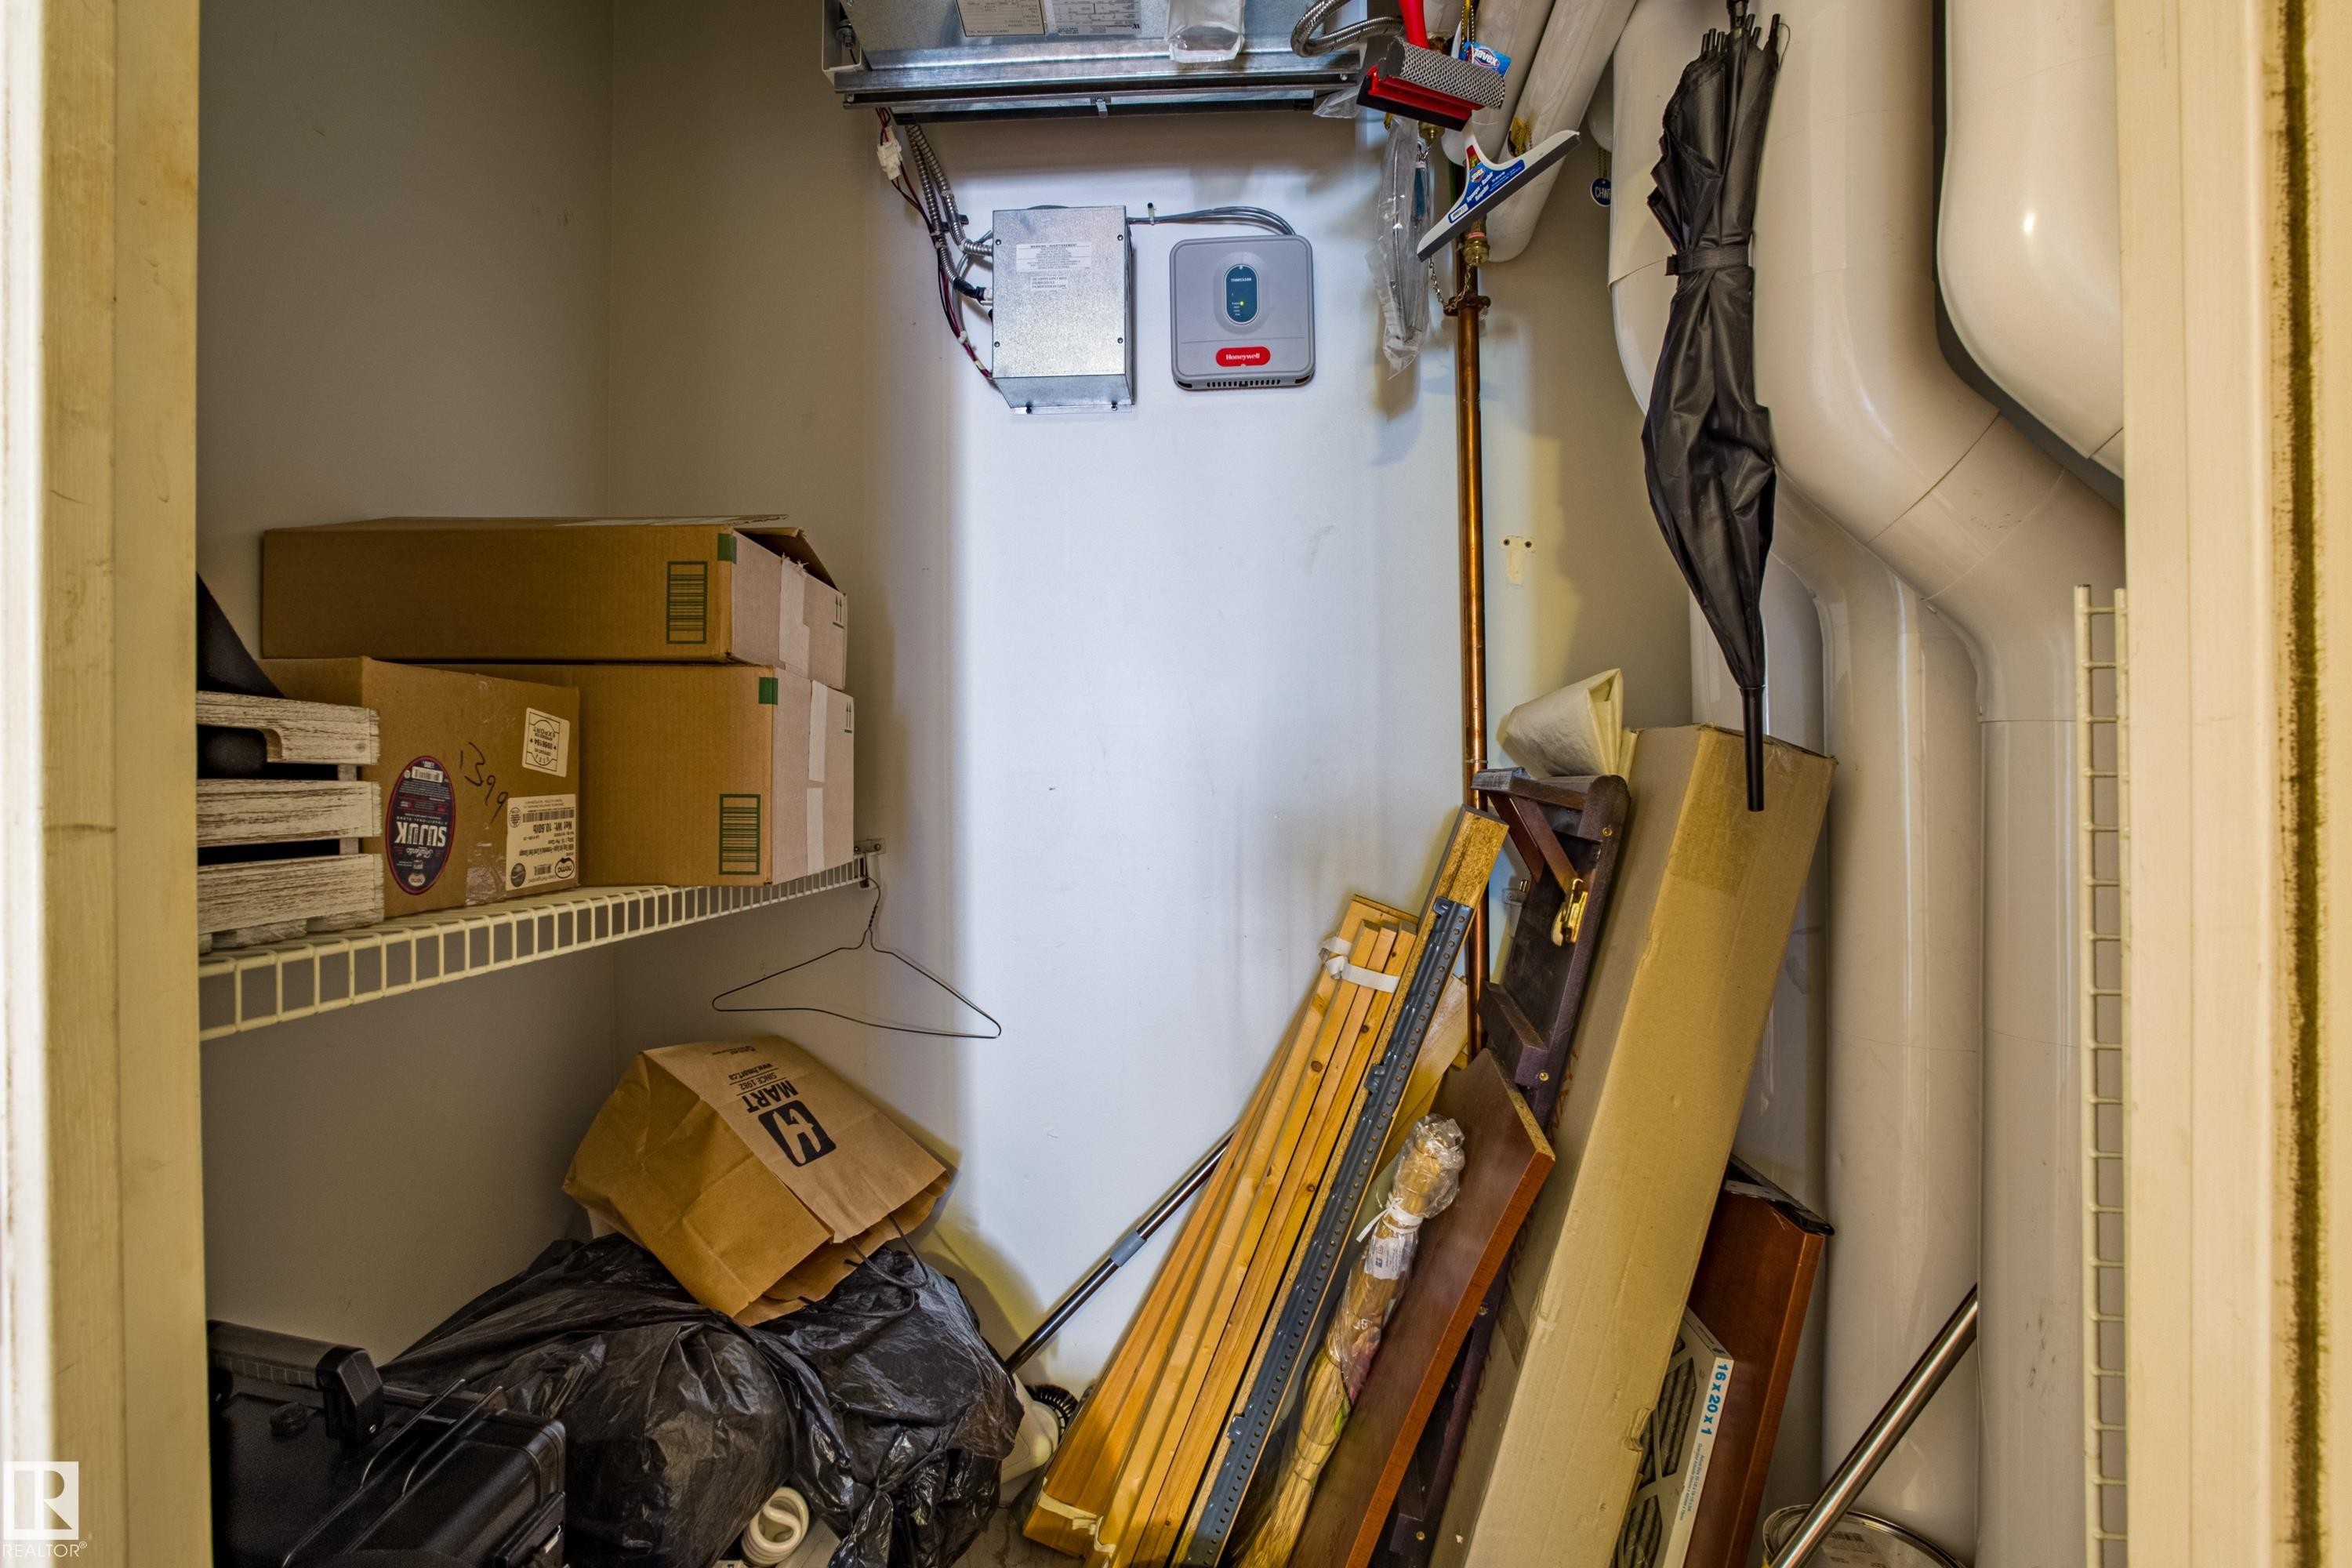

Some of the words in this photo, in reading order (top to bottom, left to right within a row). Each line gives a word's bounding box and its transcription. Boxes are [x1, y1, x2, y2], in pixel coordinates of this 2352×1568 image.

[1225, 352, 1261, 361] Honeywell
[564, 821, 572, 830] Net
[394, 822, 448, 847] SUJUK
[757, 1072, 778, 1084] SINCE
[739, 1080, 757, 1091] 1982
[741, 1080, 799, 1114] MART
[1715, 1361, 1729, 1382] 16
[1711, 1383, 1722, 1392] x
[1706, 1393, 1722, 1415] 20
[1703, 1415, 1713, 1425] x
[1700, 1427, 1712, 1437] 1
